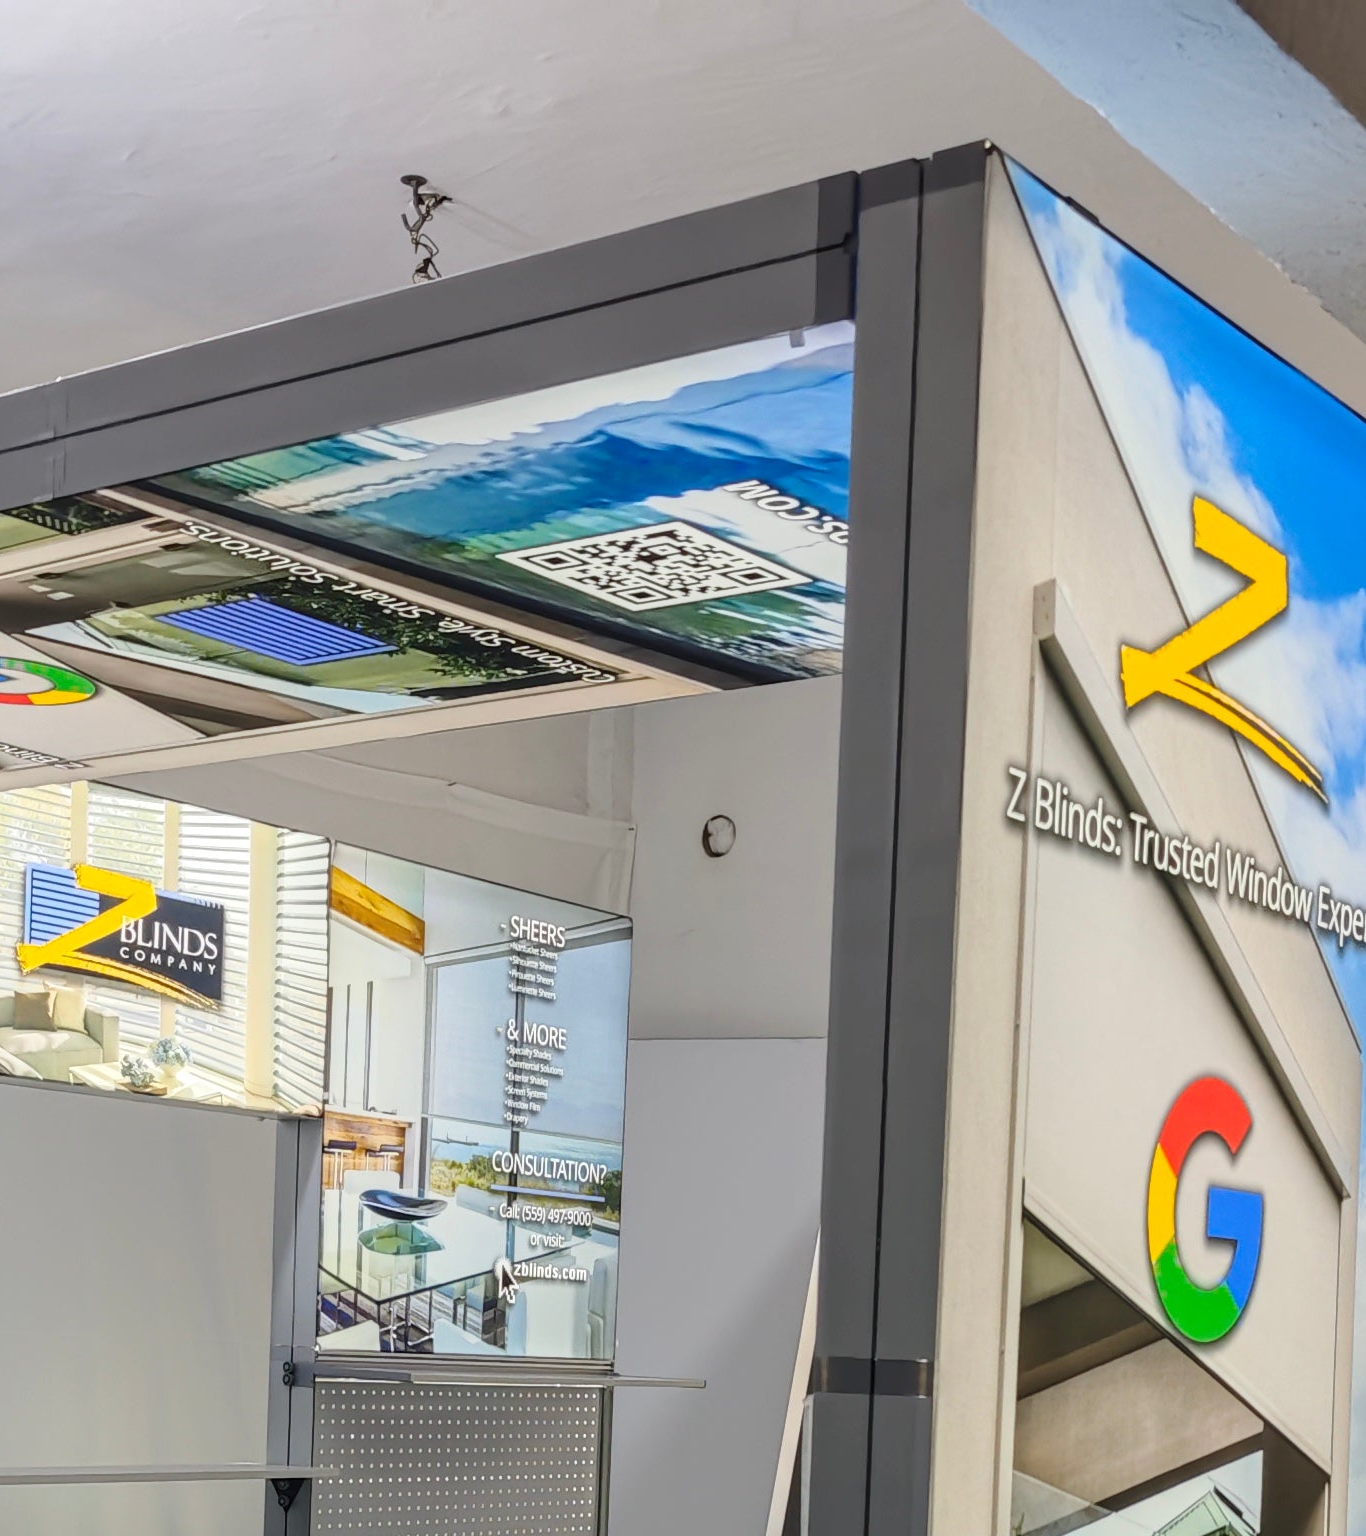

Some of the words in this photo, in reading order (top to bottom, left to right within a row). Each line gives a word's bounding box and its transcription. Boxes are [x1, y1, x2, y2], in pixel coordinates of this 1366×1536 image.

[180, 521, 339, 584] Solutions.
[332, 581, 435, 619] Smart
[438, 617, 516, 648] Style.
[511, 645, 616, 684] Custom
[54, 760, 87, 771] Z
[1006, 767, 1028, 823] Z
[1034, 777, 1123, 856] Blinds:
[1129, 812, 1221, 890] Trusted
[1225, 848, 1314, 923] Window
[119, 915, 218, 960] BLINDS
[510, 915, 566, 948] SHEERS
[119, 946, 217, 976] COMPANY
[507, 1019, 519, 1041] &
[523, 1021, 567, 1050] MORE
[492, 1150, 607, 1185] CONSULTATION?
[522, 1206, 546, 1224] (559)
[530, 1234, 541, 1246] or
[513, 1262, 587, 1282] zblinds.com
